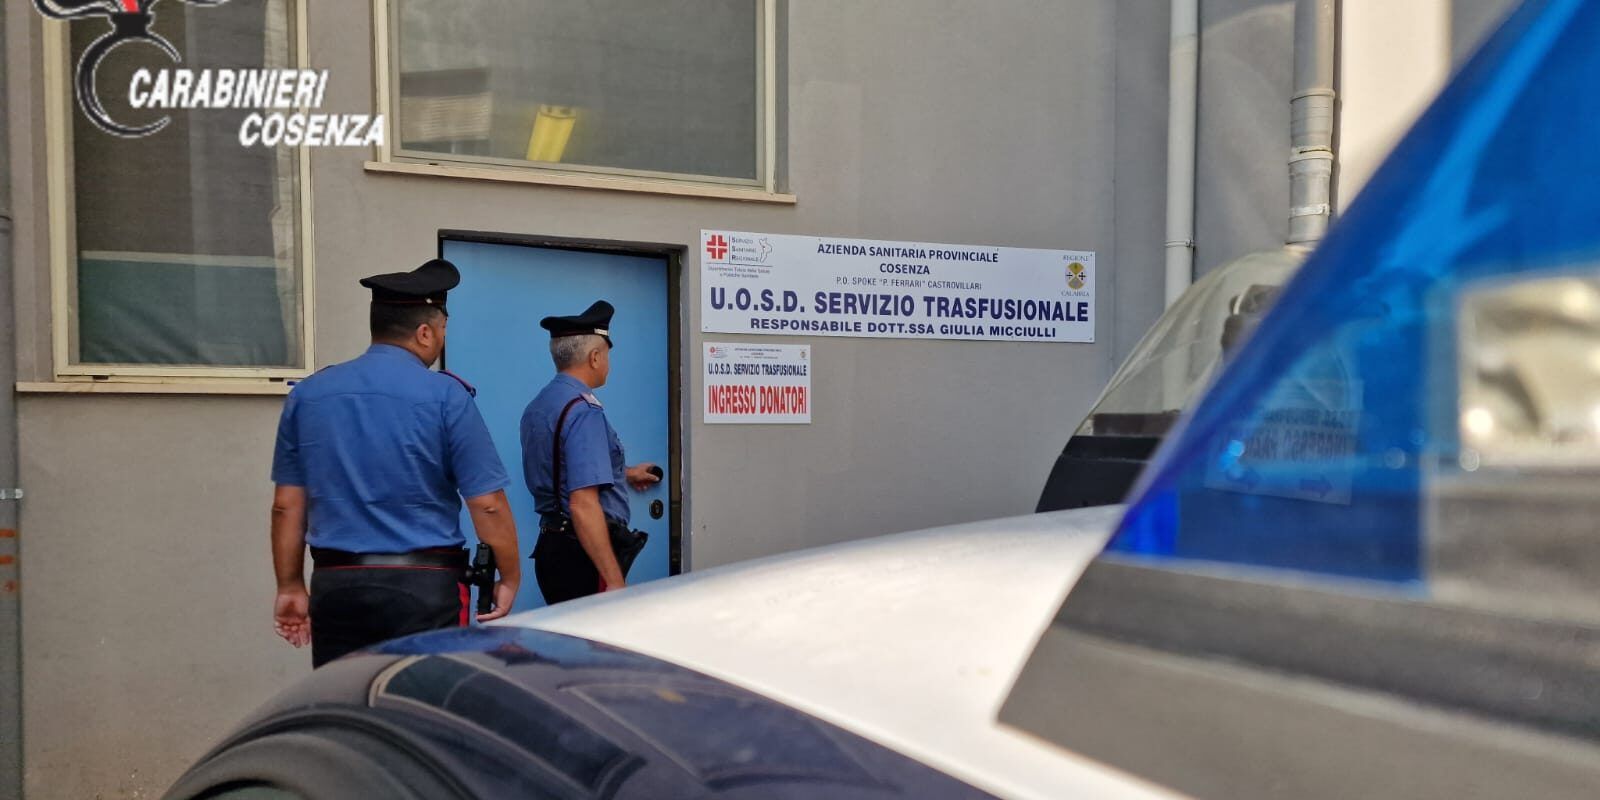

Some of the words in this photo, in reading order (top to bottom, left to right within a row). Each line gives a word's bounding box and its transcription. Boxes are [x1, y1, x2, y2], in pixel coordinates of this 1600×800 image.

[817, 243, 867, 257] AZIENDA
[869, 246, 926, 260] SANITARIA
[929, 250, 999, 263] PROVINCIALE
[879, 263, 930, 275] COSENZA
[852, 278, 877, 287] SPOKE
[891, 280, 926, 289] FERRARI"
[927, 281, 982, 290] CASTROVILLARI
[710, 287, 805, 313] U.O.S.D.
[814, 291, 915, 316] SERVIZIO
[923, 296, 1089, 322] TRASFUSIONALE
[750, 317, 862, 333] RESPONSABILE
[867, 321, 935, 334] DOTT.SSA
[940, 324, 985, 336] GIULIA
[989, 326, 1056, 337] MICCIULLI
[708, 362, 732, 375] U.O.S.D.
[733, 363, 760, 375] SERVIZIO
[762, 364, 807, 376] TRASFUSIONALE
[708, 384, 756, 414] INGRESSO
[759, 386, 807, 415] DONATORI
